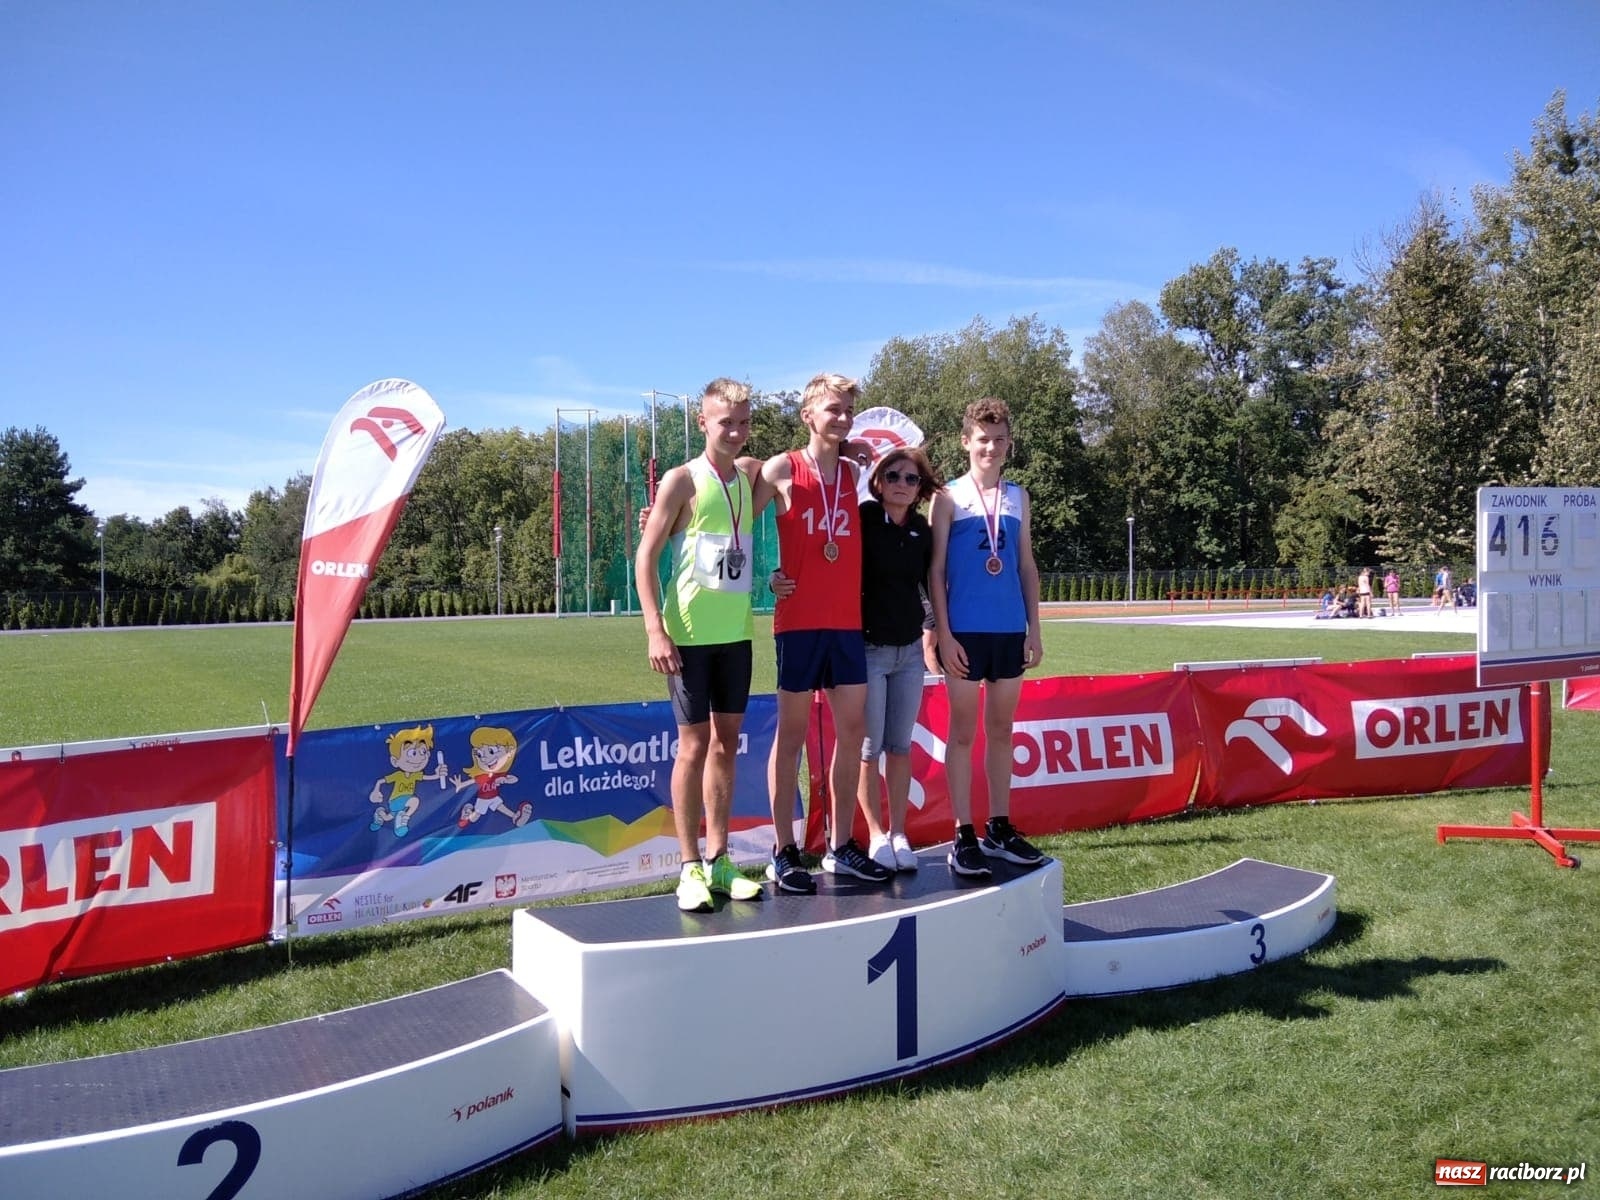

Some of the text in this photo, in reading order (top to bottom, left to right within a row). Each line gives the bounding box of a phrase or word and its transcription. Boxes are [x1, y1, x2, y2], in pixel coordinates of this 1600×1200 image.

[1491, 491, 1597, 508] ZAWODNIK PRÓBA
[311, 560, 369, 578] ORLEN
[1528, 573, 1563, 587] WYNIK
[1365, 697, 1511, 749] ORLEN
[1012, 722, 1164, 778] ORLEN
[544, 770, 656, 797] dla każdego!
[309, 912, 342, 924] ORLEN
[1249, 923, 1266, 965] 3
[867, 915, 918, 1062] 1
[466, 1086, 515, 1119] polanik
[177, 1120, 262, 1200] 2
